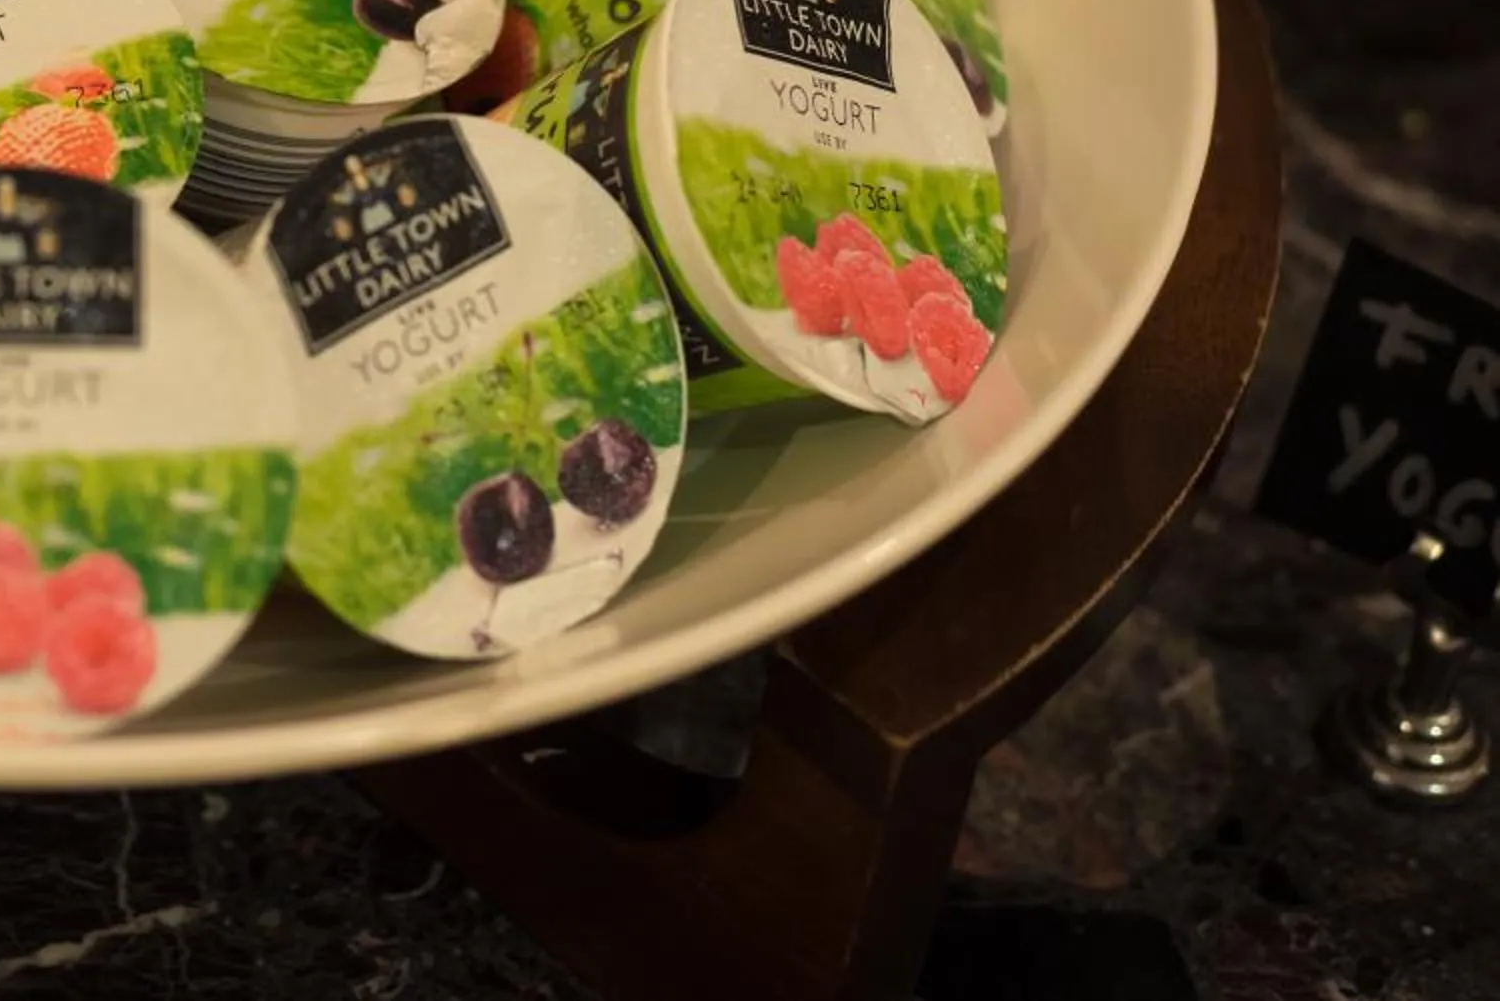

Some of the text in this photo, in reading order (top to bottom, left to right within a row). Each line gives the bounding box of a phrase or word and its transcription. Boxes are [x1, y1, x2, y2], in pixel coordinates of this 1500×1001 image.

[787, 29, 850, 65] DAIRY
[815, 8, 884, 49] TOWN
[768, 78, 883, 136] YOGURT
[849, 179, 903, 215] 7361
[295, 186, 487, 306] LITTLE TOWN
[12, 264, 134, 301] TOWN
[356, 247, 445, 308] DAIRY
[349, 282, 501, 385] YOGURT
[1327, 401, 1500, 567] YOG
